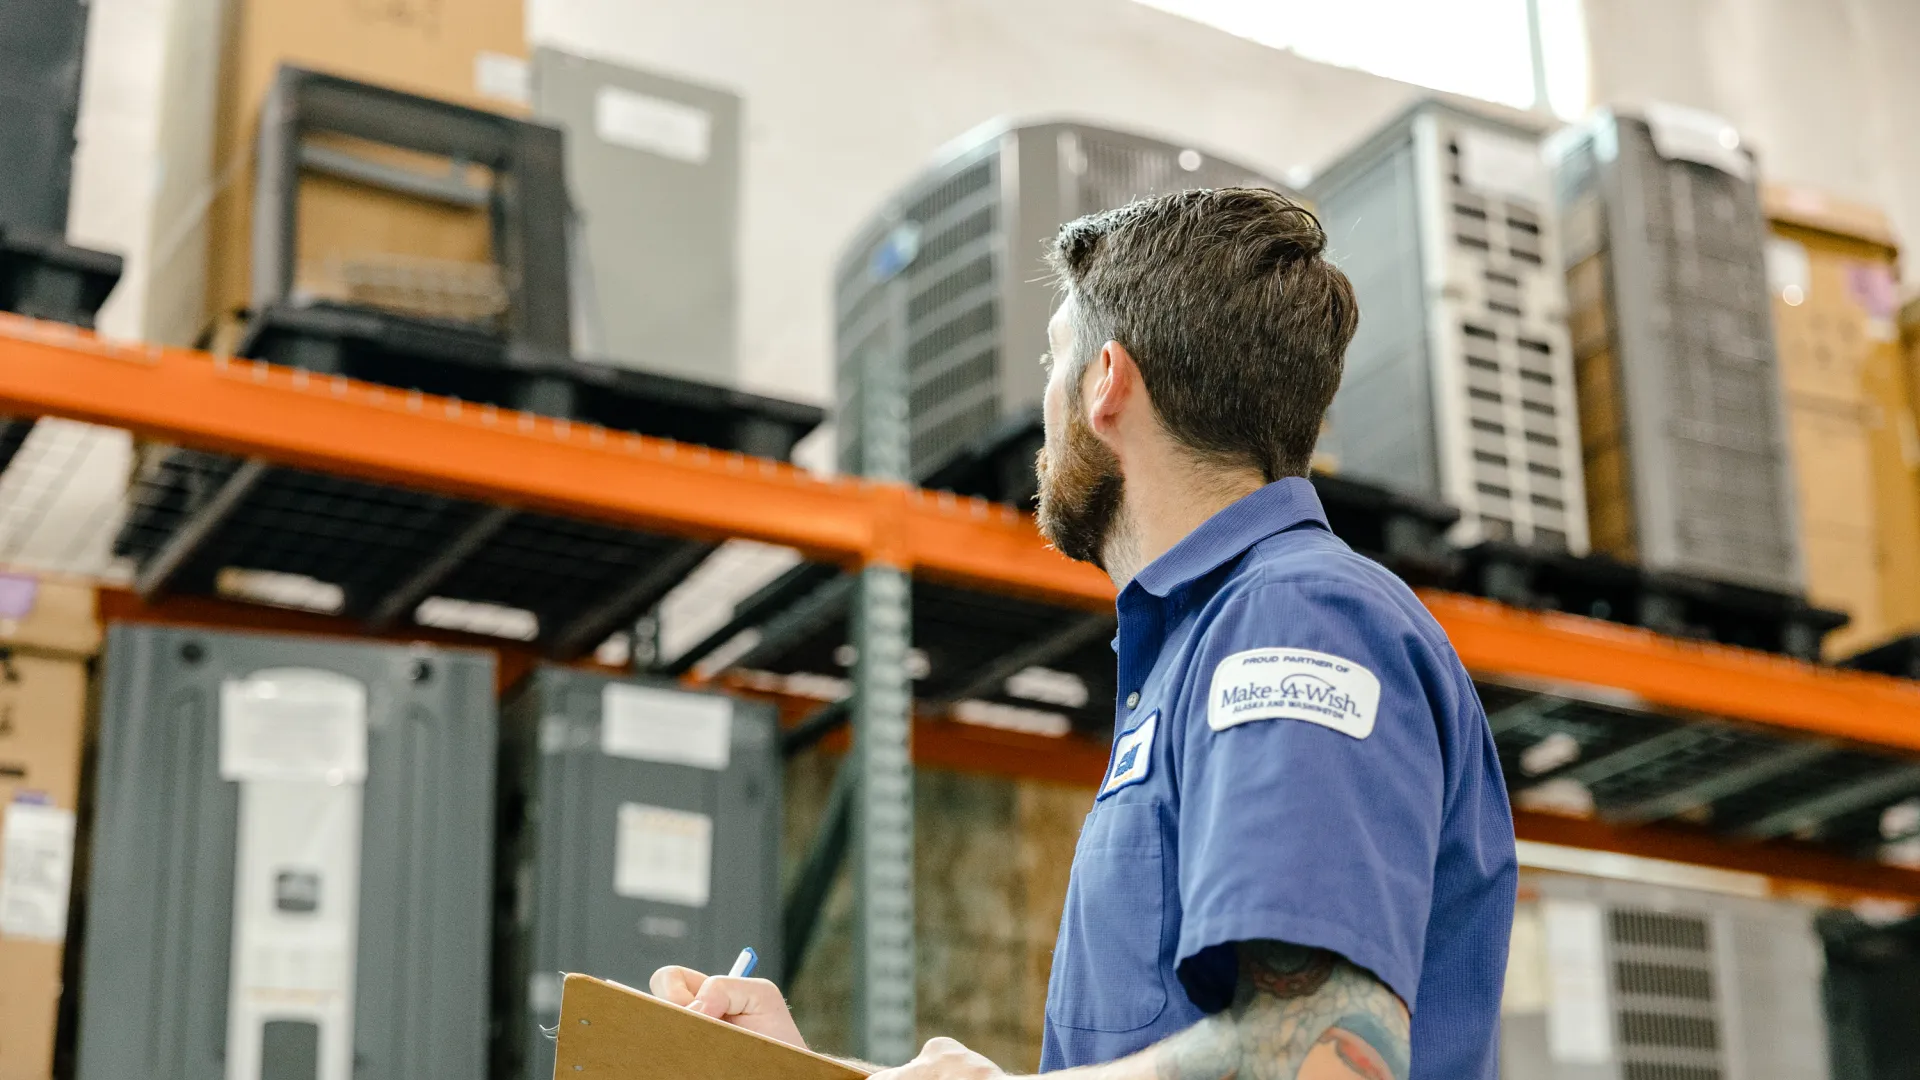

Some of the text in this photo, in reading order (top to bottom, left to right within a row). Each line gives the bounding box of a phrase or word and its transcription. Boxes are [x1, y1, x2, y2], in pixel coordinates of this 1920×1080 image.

[1242, 656, 1350, 673] PROUD PARTNER OF
[1234, 701, 1264, 713] ALASKA
[1288, 701, 1344, 719] WASHINGTON
